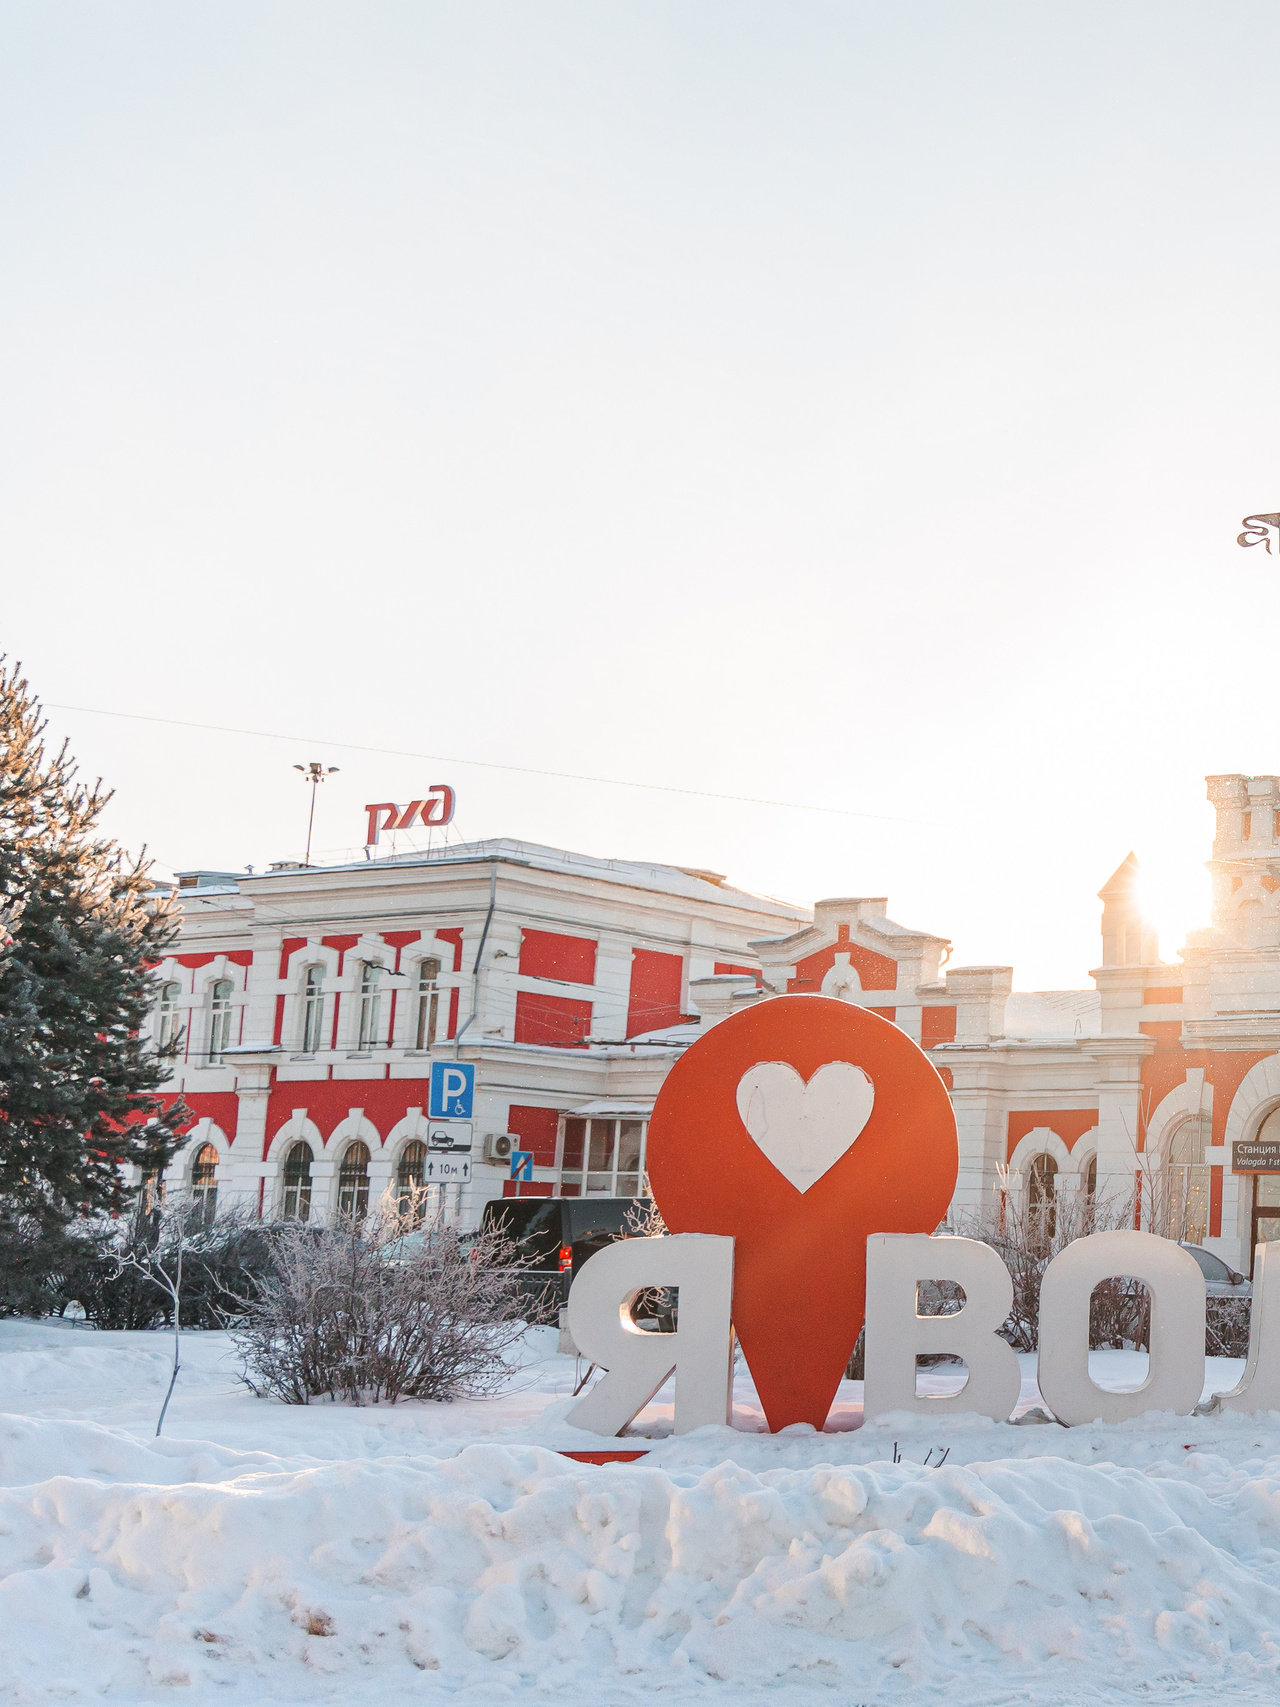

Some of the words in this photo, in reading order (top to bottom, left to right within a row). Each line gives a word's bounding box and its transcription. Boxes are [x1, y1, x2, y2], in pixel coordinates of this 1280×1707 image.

[442, 1068, 467, 1112] P
[1236, 1157, 1267, 1168] Vologda
[1237, 1144, 1277, 1155] Станция
[566, 1234, 735, 1437] Я
